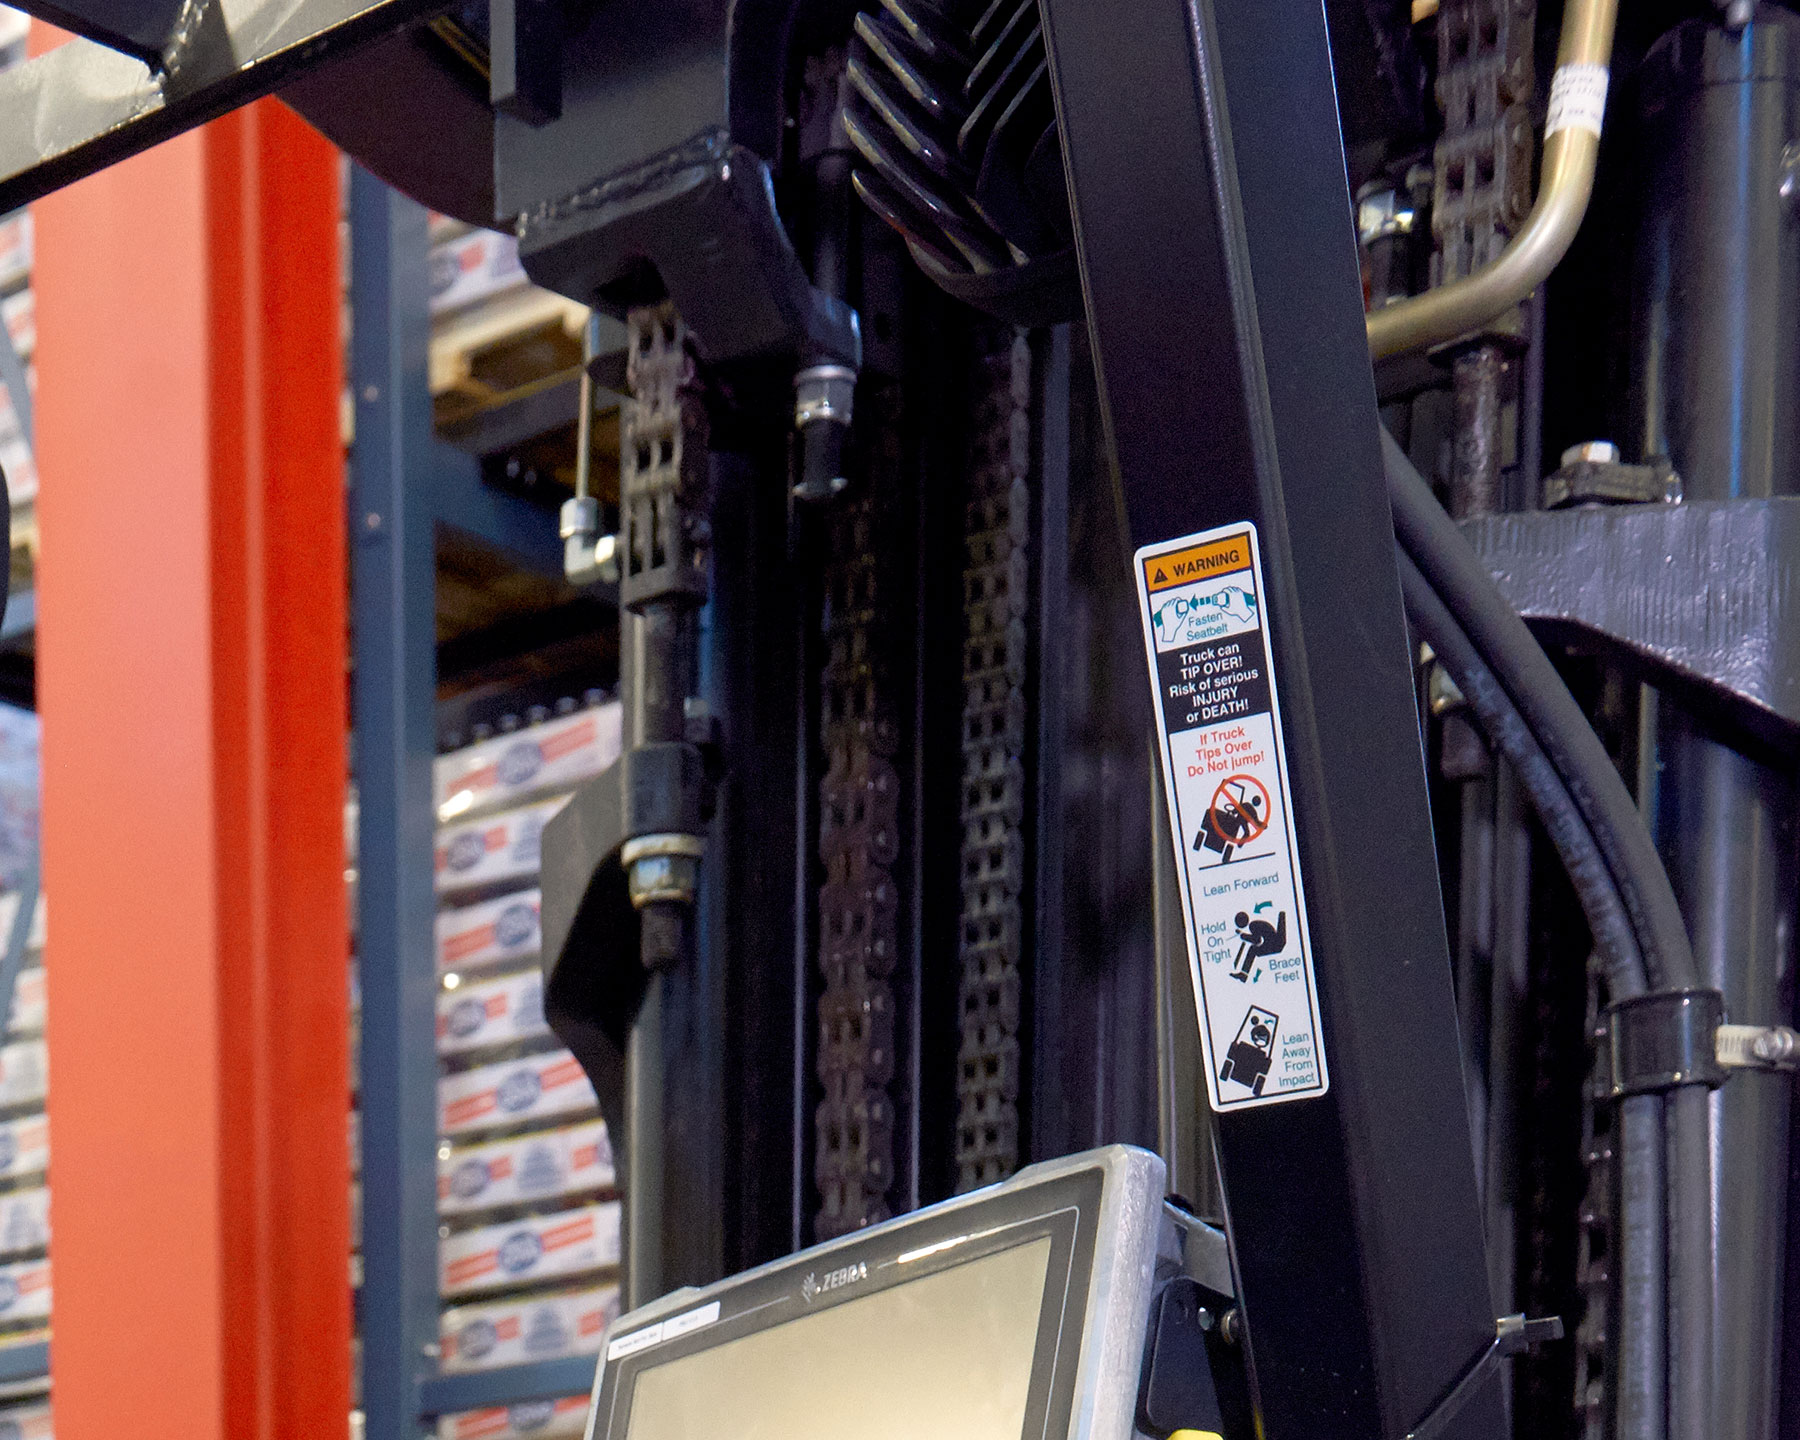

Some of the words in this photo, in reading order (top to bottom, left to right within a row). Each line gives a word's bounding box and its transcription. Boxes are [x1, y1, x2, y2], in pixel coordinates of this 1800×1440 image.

[1173, 550, 1239, 577] WARNING
[1189, 611, 1223, 627] Fasten
[1187, 623, 1228, 641] Seatbelt
[1180, 648, 1215, 665] Truck
[1218, 643, 1239, 655] can
[1180, 666, 1201, 680] TIP
[1204, 656, 1242, 676] OVER!
[1170, 683, 1196, 698] Risk
[1199, 680, 1211, 691] of
[1214, 669, 1258, 687] serious
[1192, 687, 1238, 707] INJURY
[1186, 712, 1199, 723] or
[1203, 699, 1249, 721] DEATH!
[1200, 735, 1208, 745] If
[1211, 726, 1245, 742] Truck
[1196, 747, 1221, 762] Tips
[1224, 740, 1252, 756] Over
[1188, 766, 1204, 777] Do
[1207, 760, 1229, 773] Not
[1232, 751, 1264, 768] jump!
[1203, 883, 1230, 897] Lean
[1234, 873, 1279, 892] Forward
[1201, 921, 1226, 934] Hold
[1207, 935, 1224, 947] On
[1204, 948, 1231, 965] Tight
[1269, 956, 1301, 971] Brace
[1274, 970, 1300, 984] Feet
[1282, 1032, 1309, 1045] Lean
[1282, 1046, 1311, 1060] Away
[1285, 1059, 1313, 1072] From
[1279, 1073, 1316, 1088] Impact
[822, 1261, 867, 1292] ZEBRA
